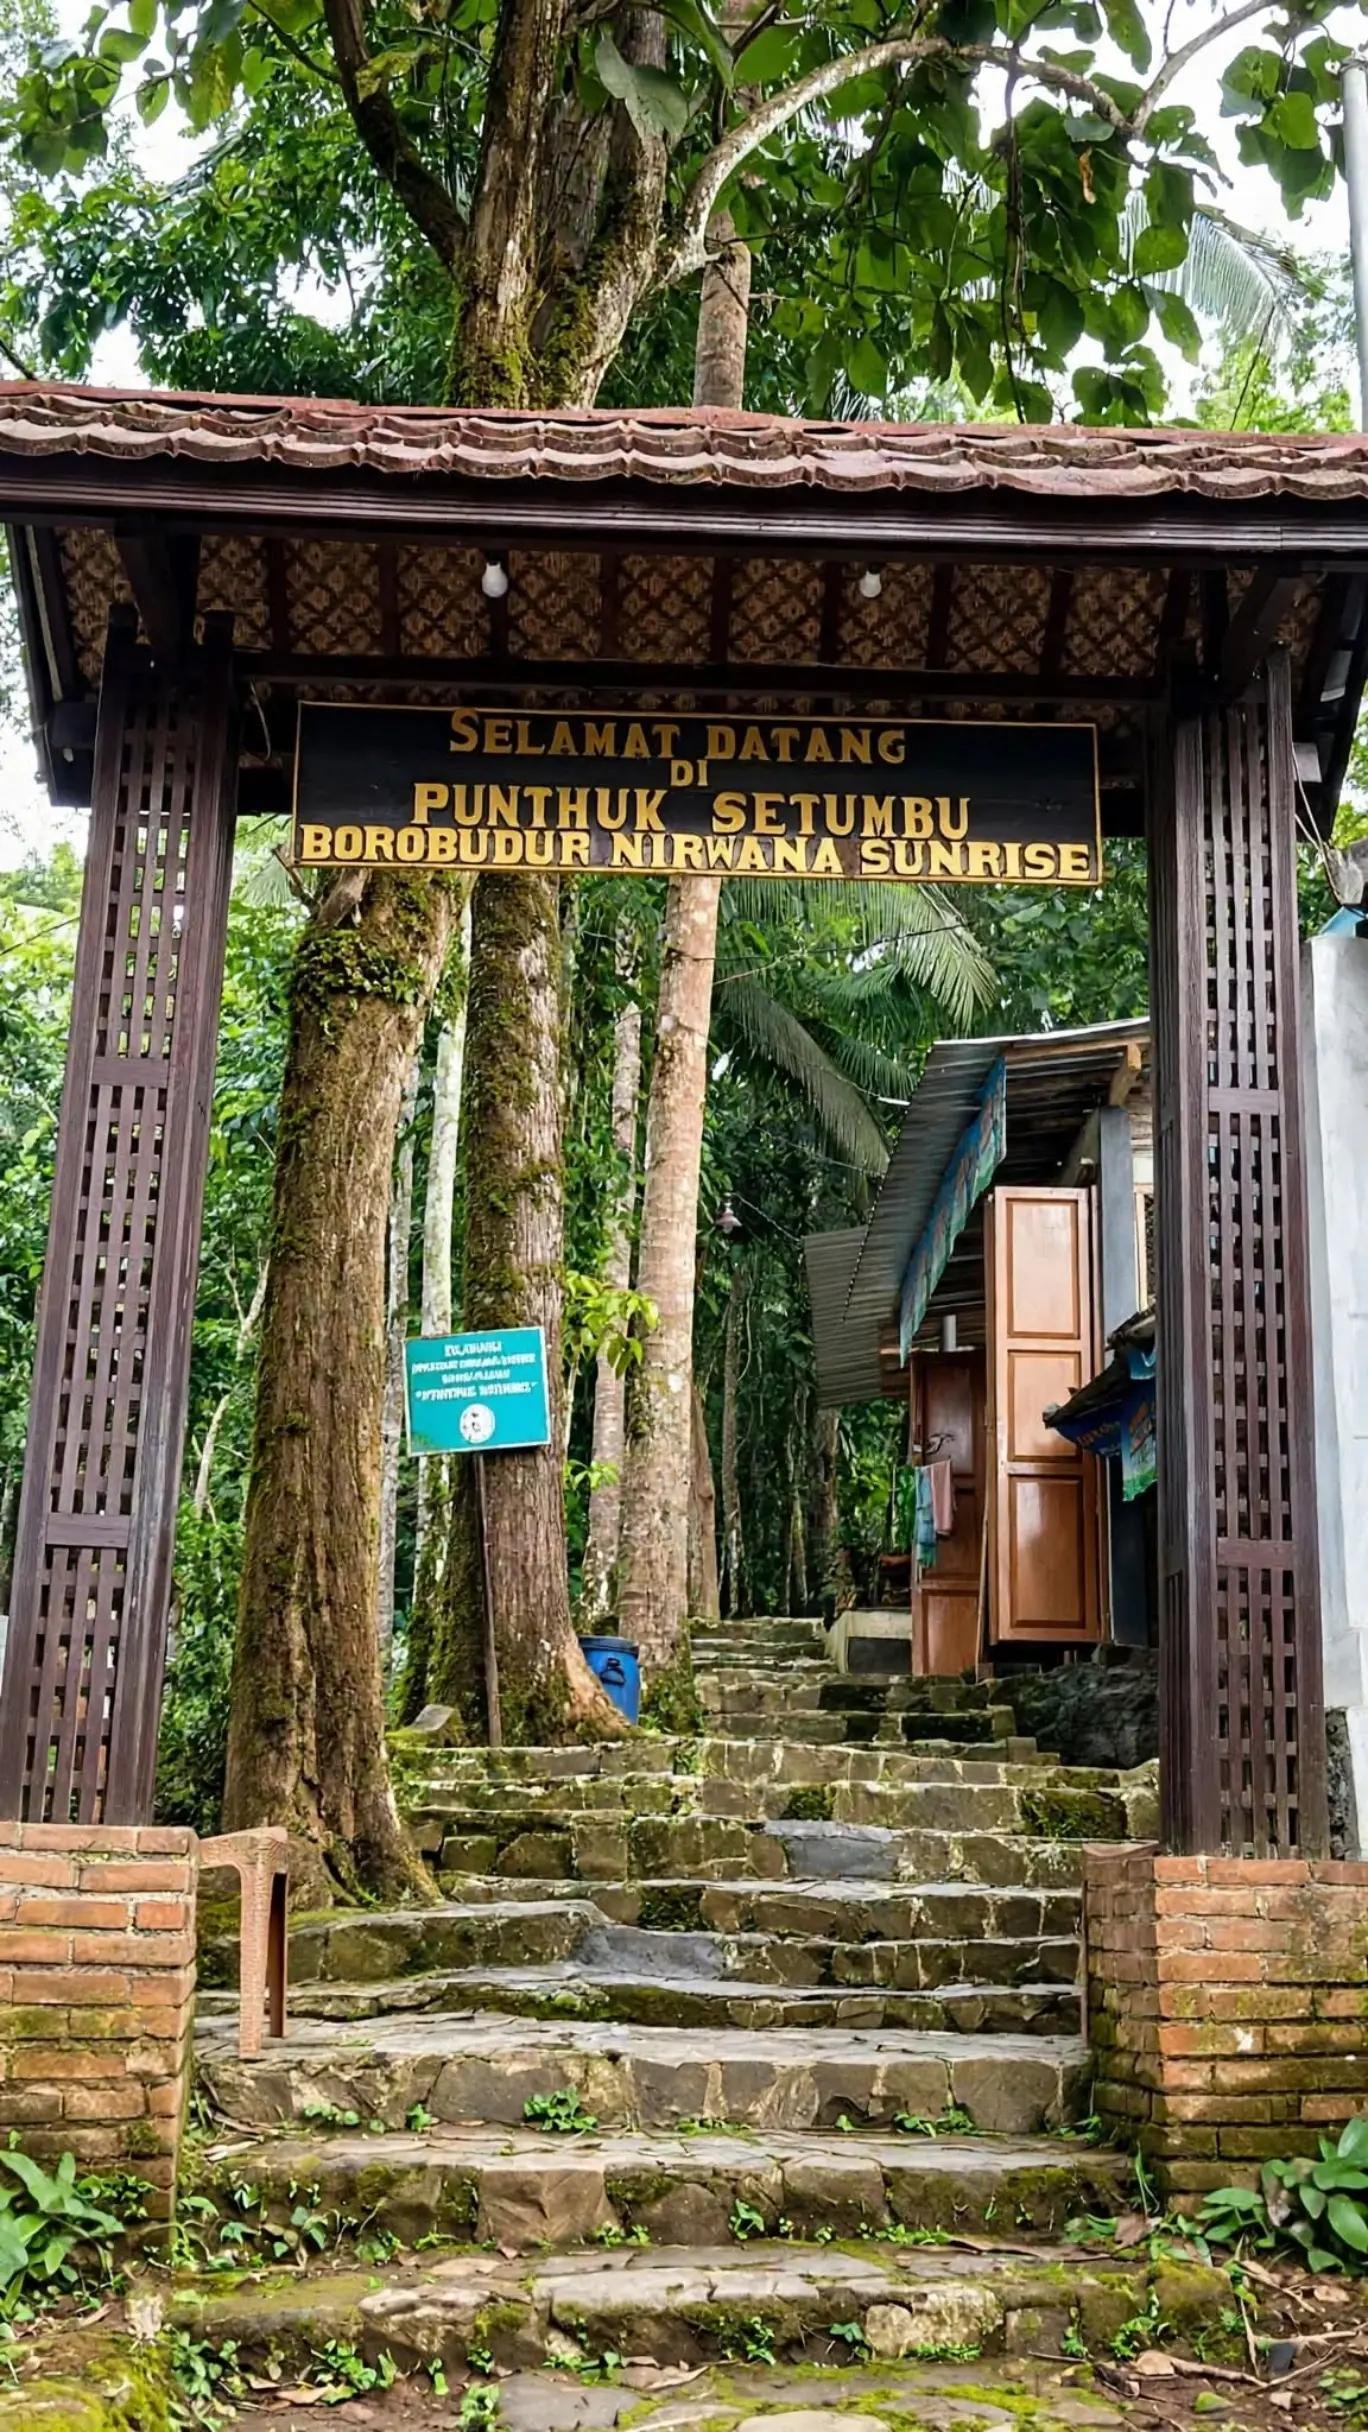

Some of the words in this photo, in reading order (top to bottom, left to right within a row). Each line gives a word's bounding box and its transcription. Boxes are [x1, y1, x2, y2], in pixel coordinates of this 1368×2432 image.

[449, 707, 680, 760] SELAMAT
[706, 724, 906, 764] DATANG
[670, 759, 708, 787] DI
[411, 782, 669, 832] PUNTHUK
[712, 792, 971, 841] SETUMBU
[300, 824, 592, 867] BOROBUDUR
[610, 832, 844, 875] NIRWANA
[860, 837, 1091, 880] SUNRISE
